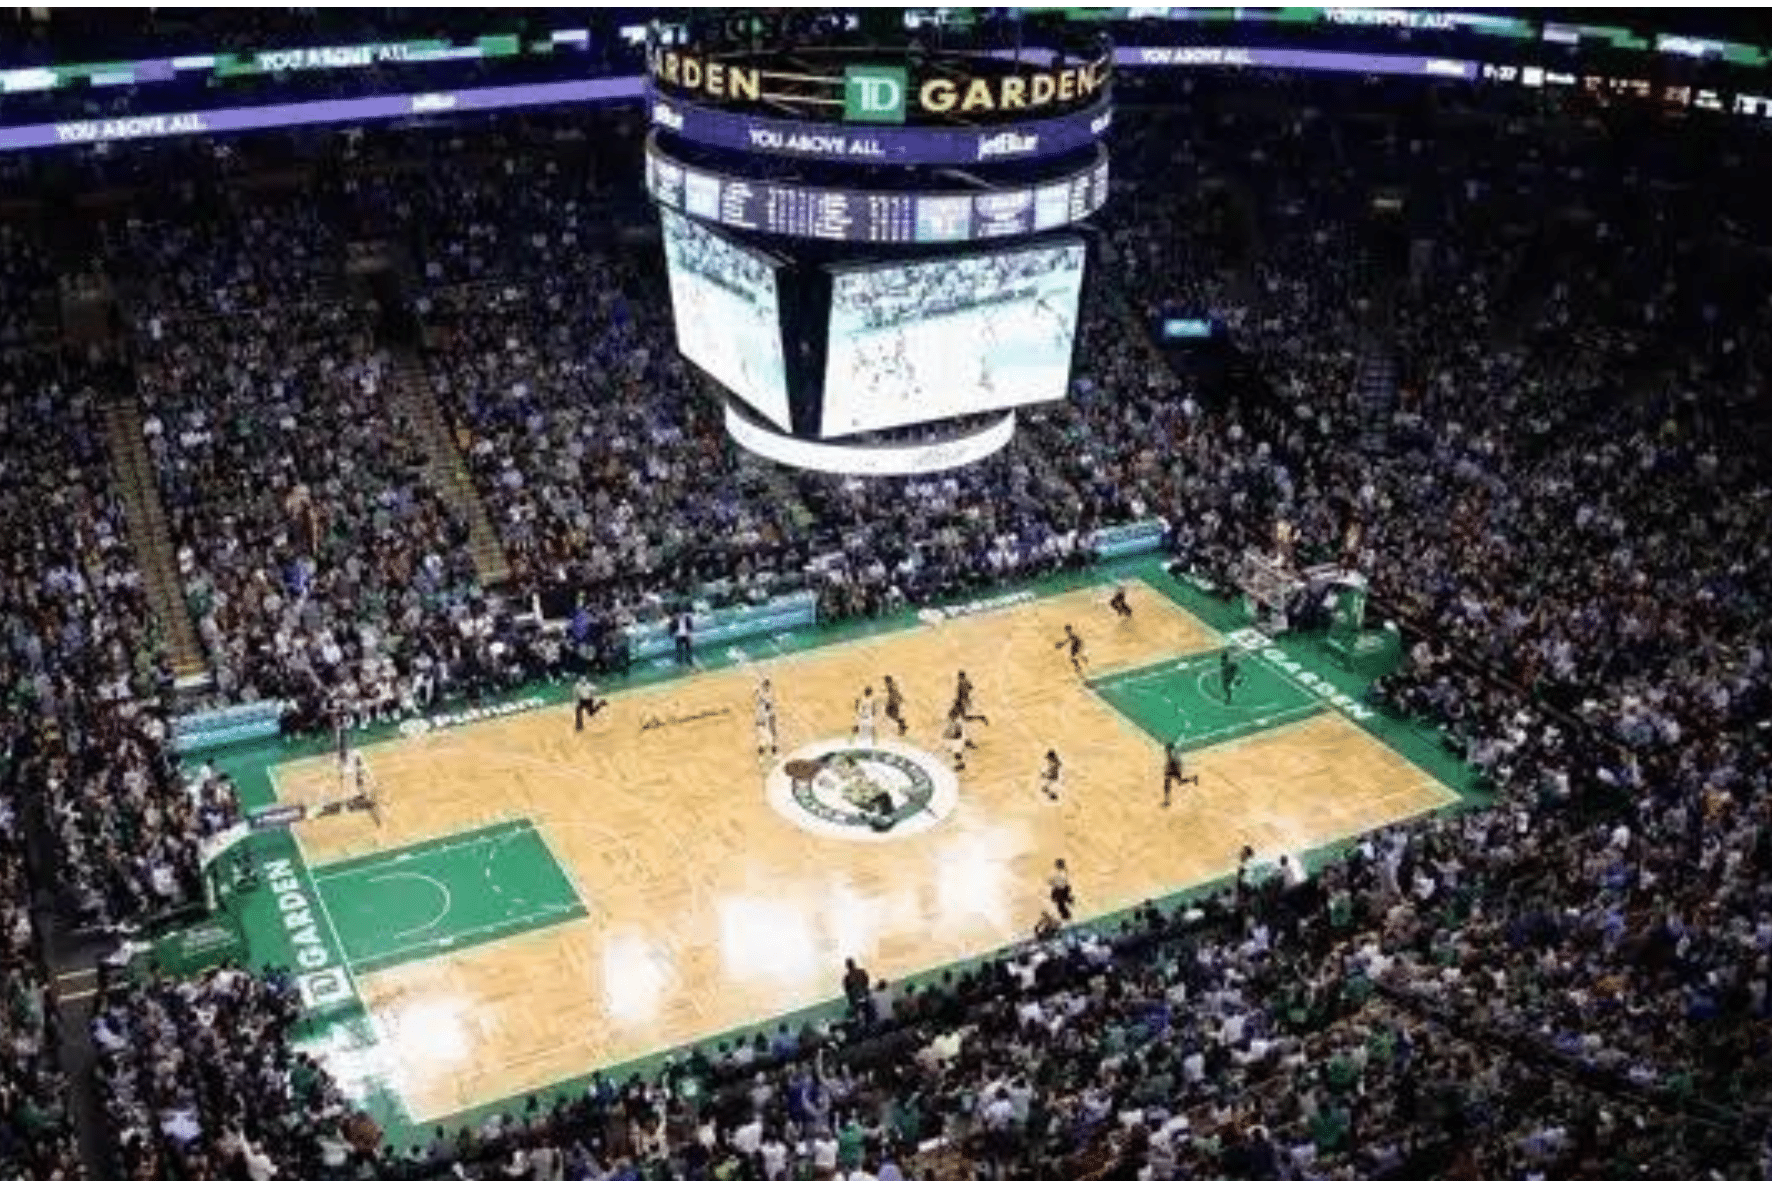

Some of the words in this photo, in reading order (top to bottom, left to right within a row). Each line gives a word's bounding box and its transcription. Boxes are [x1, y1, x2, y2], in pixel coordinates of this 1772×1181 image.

[851, 76, 899, 112] TD
[919, 63, 1097, 113] GARDEN
[56, 123, 97, 142] YOU
[103, 117, 164, 139] ABOVE
[749, 128, 783, 148] YOU
[787, 133, 845, 155] ABOVE
[263, 858, 328, 968] GARDEN
